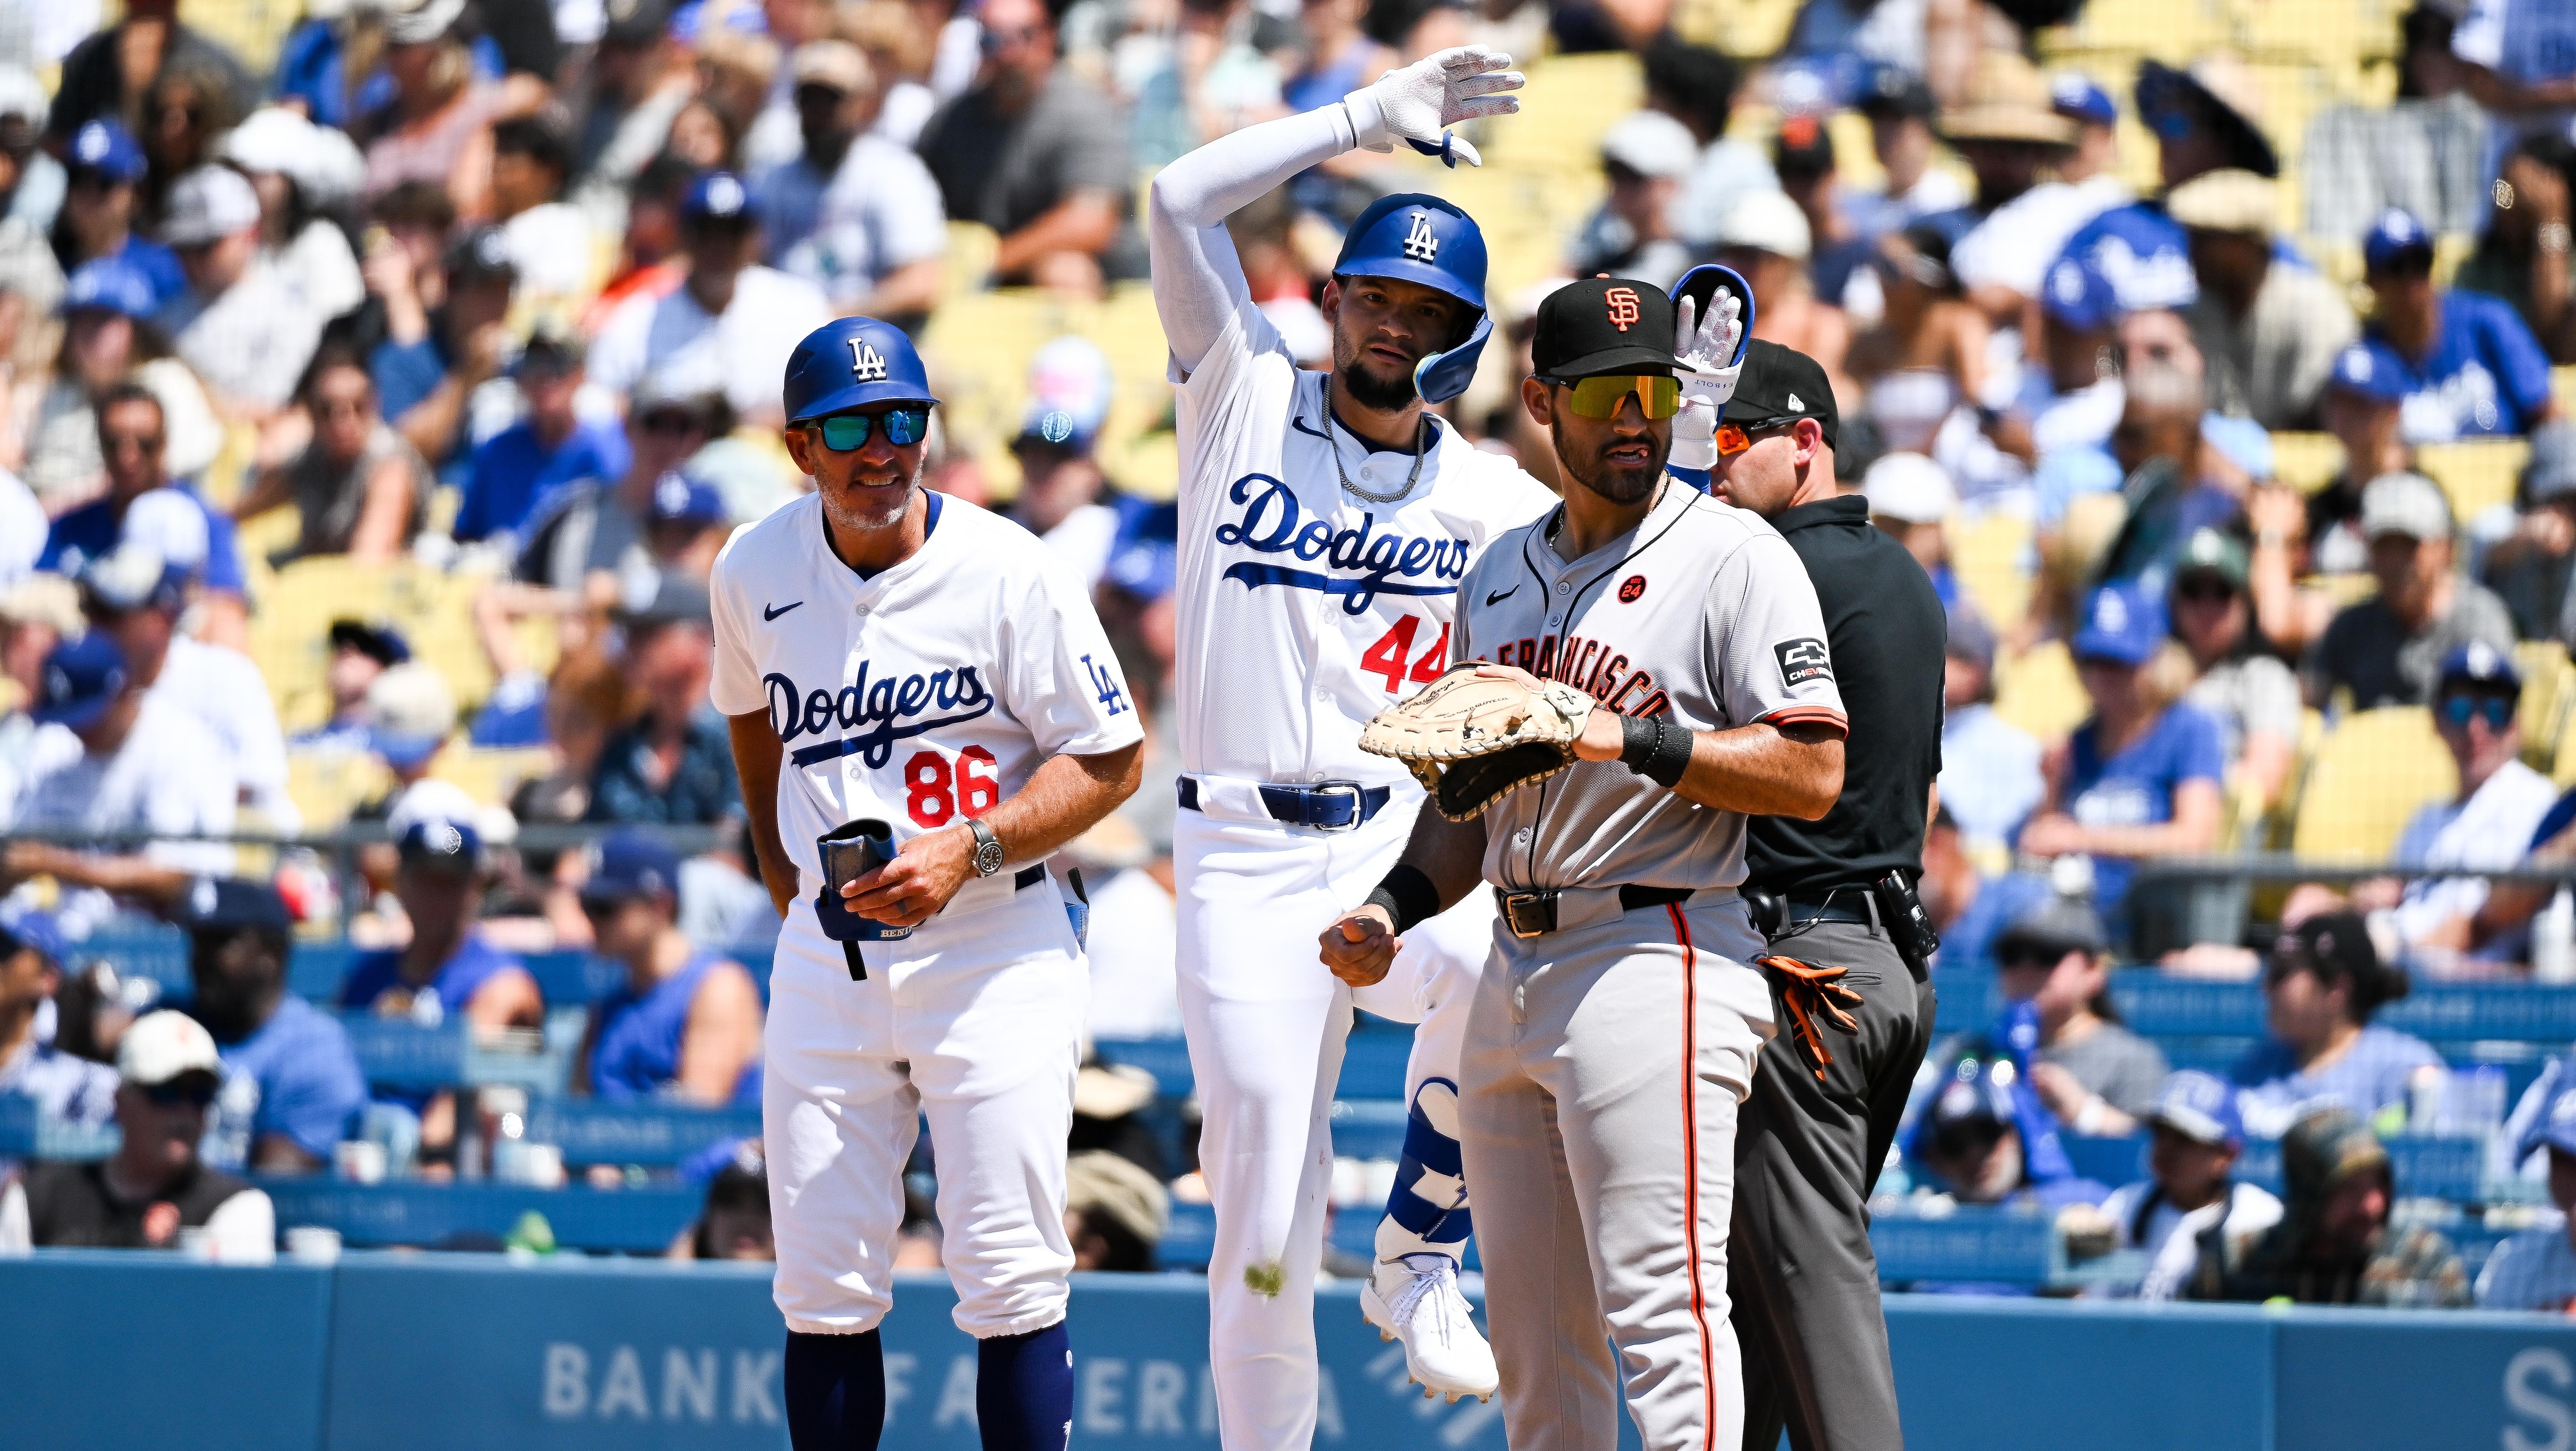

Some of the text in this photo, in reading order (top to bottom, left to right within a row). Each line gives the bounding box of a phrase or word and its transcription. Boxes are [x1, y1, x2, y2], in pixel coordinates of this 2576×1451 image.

[1403, 211, 1439, 261] LA
[1604, 286, 1640, 332] SF
[848, 336, 887, 381] LA
[1216, 473, 1470, 616] Dodgers
[1621, 584, 1642, 597] 24
[763, 659, 994, 770] Dodgers
[1079, 653, 1129, 716] LA
[904, 744, 999, 829] 86
[542, 1341, 781, 1424] BANK
